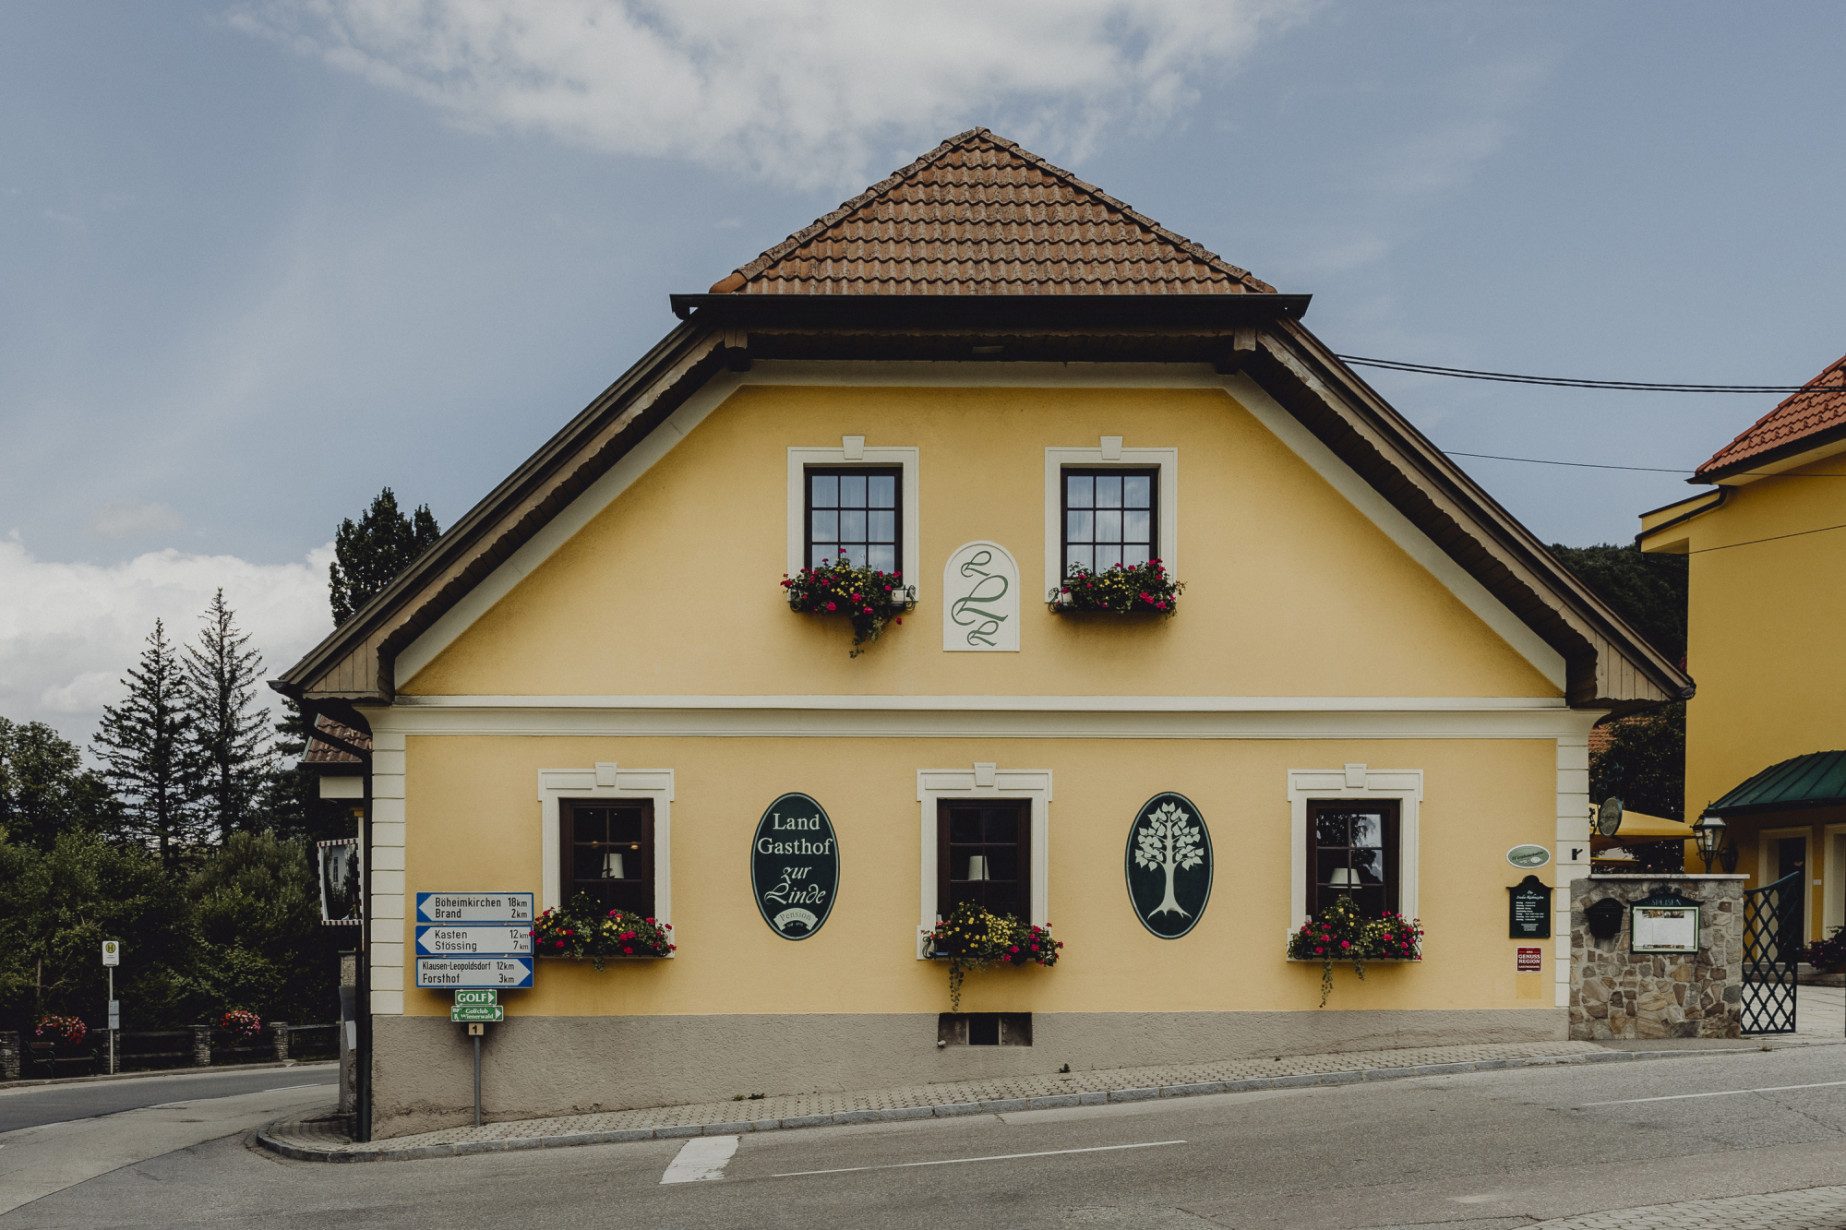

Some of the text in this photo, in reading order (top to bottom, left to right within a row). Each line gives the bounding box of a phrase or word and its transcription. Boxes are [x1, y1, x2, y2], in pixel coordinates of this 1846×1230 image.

[772, 813, 820, 830] Land
[758, 837, 832, 854] Gasthof
[780, 866, 812, 884] zur
[764, 882, 826, 904] Linde
[435, 897, 528, 908] Böheimkirchen 18km
[435, 908, 528, 918] Brand 2km
[780, 912, 812, 921] Pension
[434, 930, 468, 939] Kasten
[435, 941, 477, 952] Stössing
[422, 962, 514, 972] Klausen-Leopoldsdorf 12km
[422, 974, 514, 984] Forsthof 3km
[458, 994, 486, 1002] GOLF
[472, 1024, 478, 1034] 1
